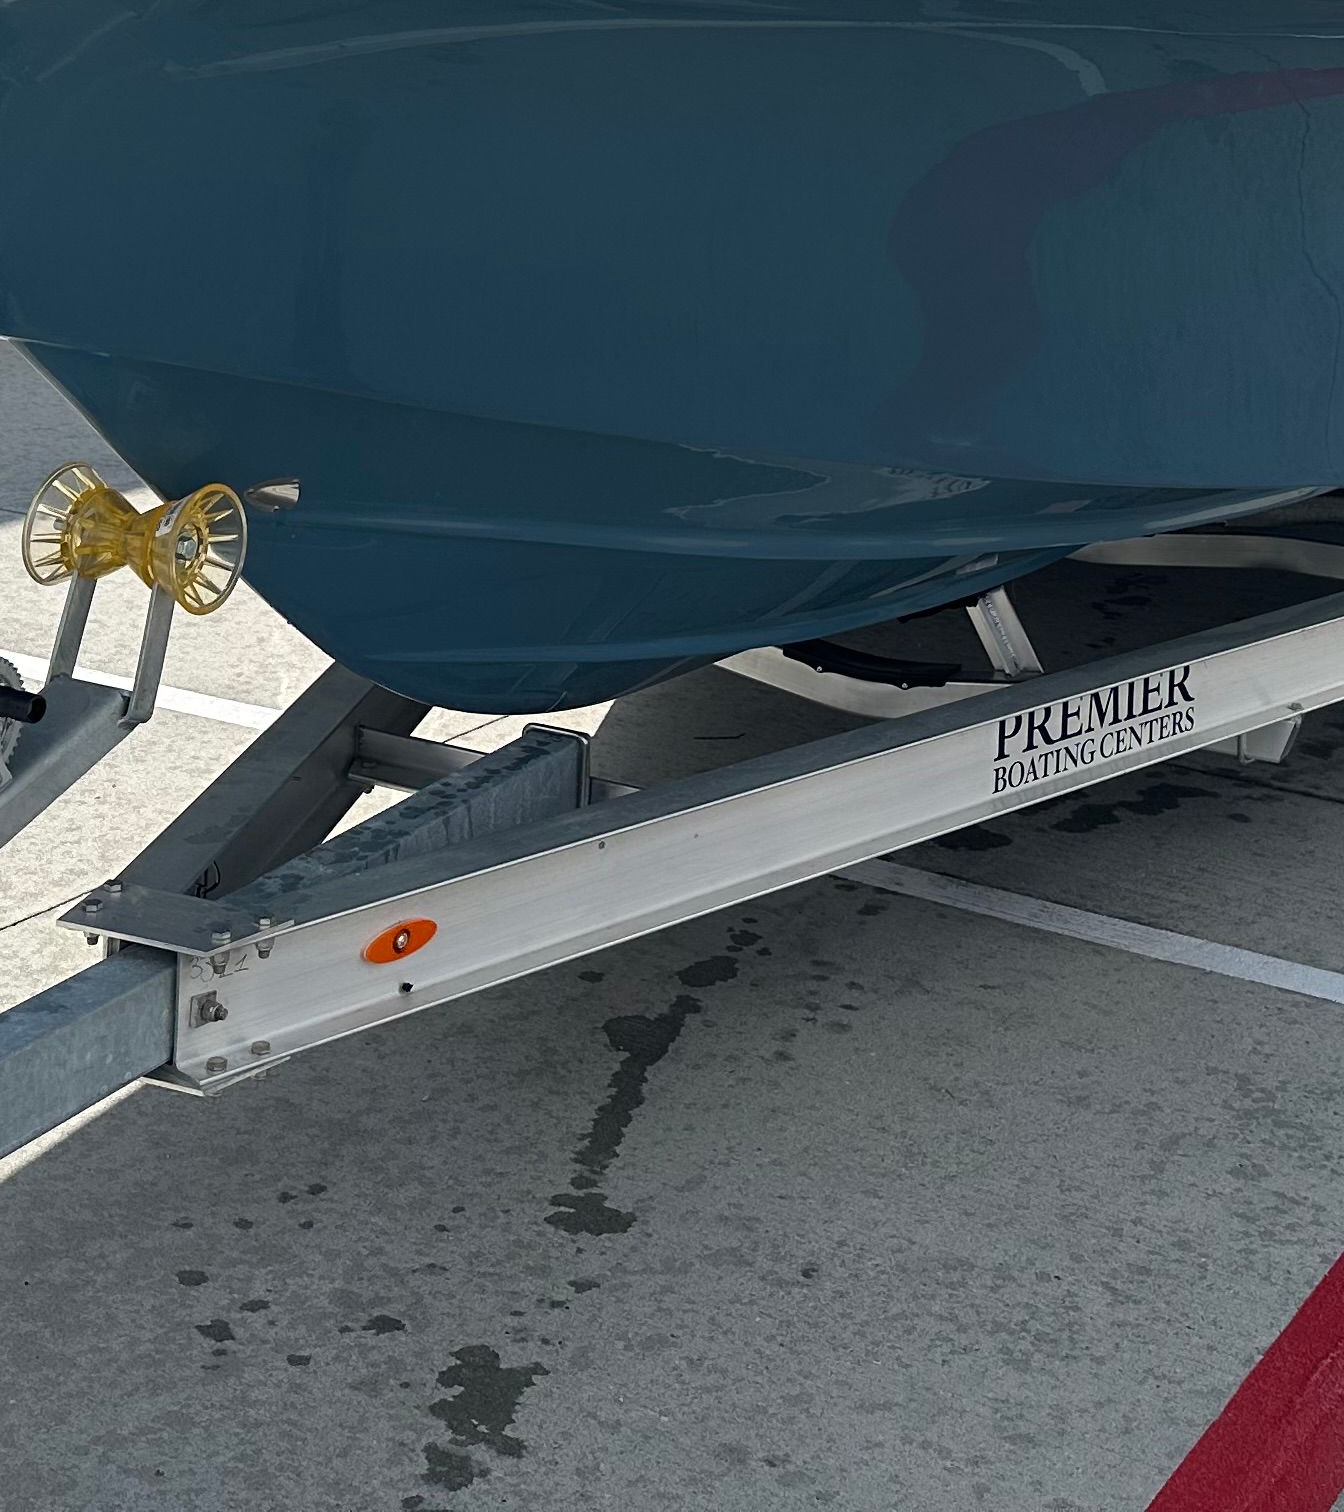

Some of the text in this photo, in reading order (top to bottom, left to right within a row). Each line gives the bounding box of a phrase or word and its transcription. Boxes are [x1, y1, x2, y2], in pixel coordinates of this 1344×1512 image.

[992, 706, 1196, 794] BOATING CENTERS
[994, 665, 1195, 762] PREMIER
